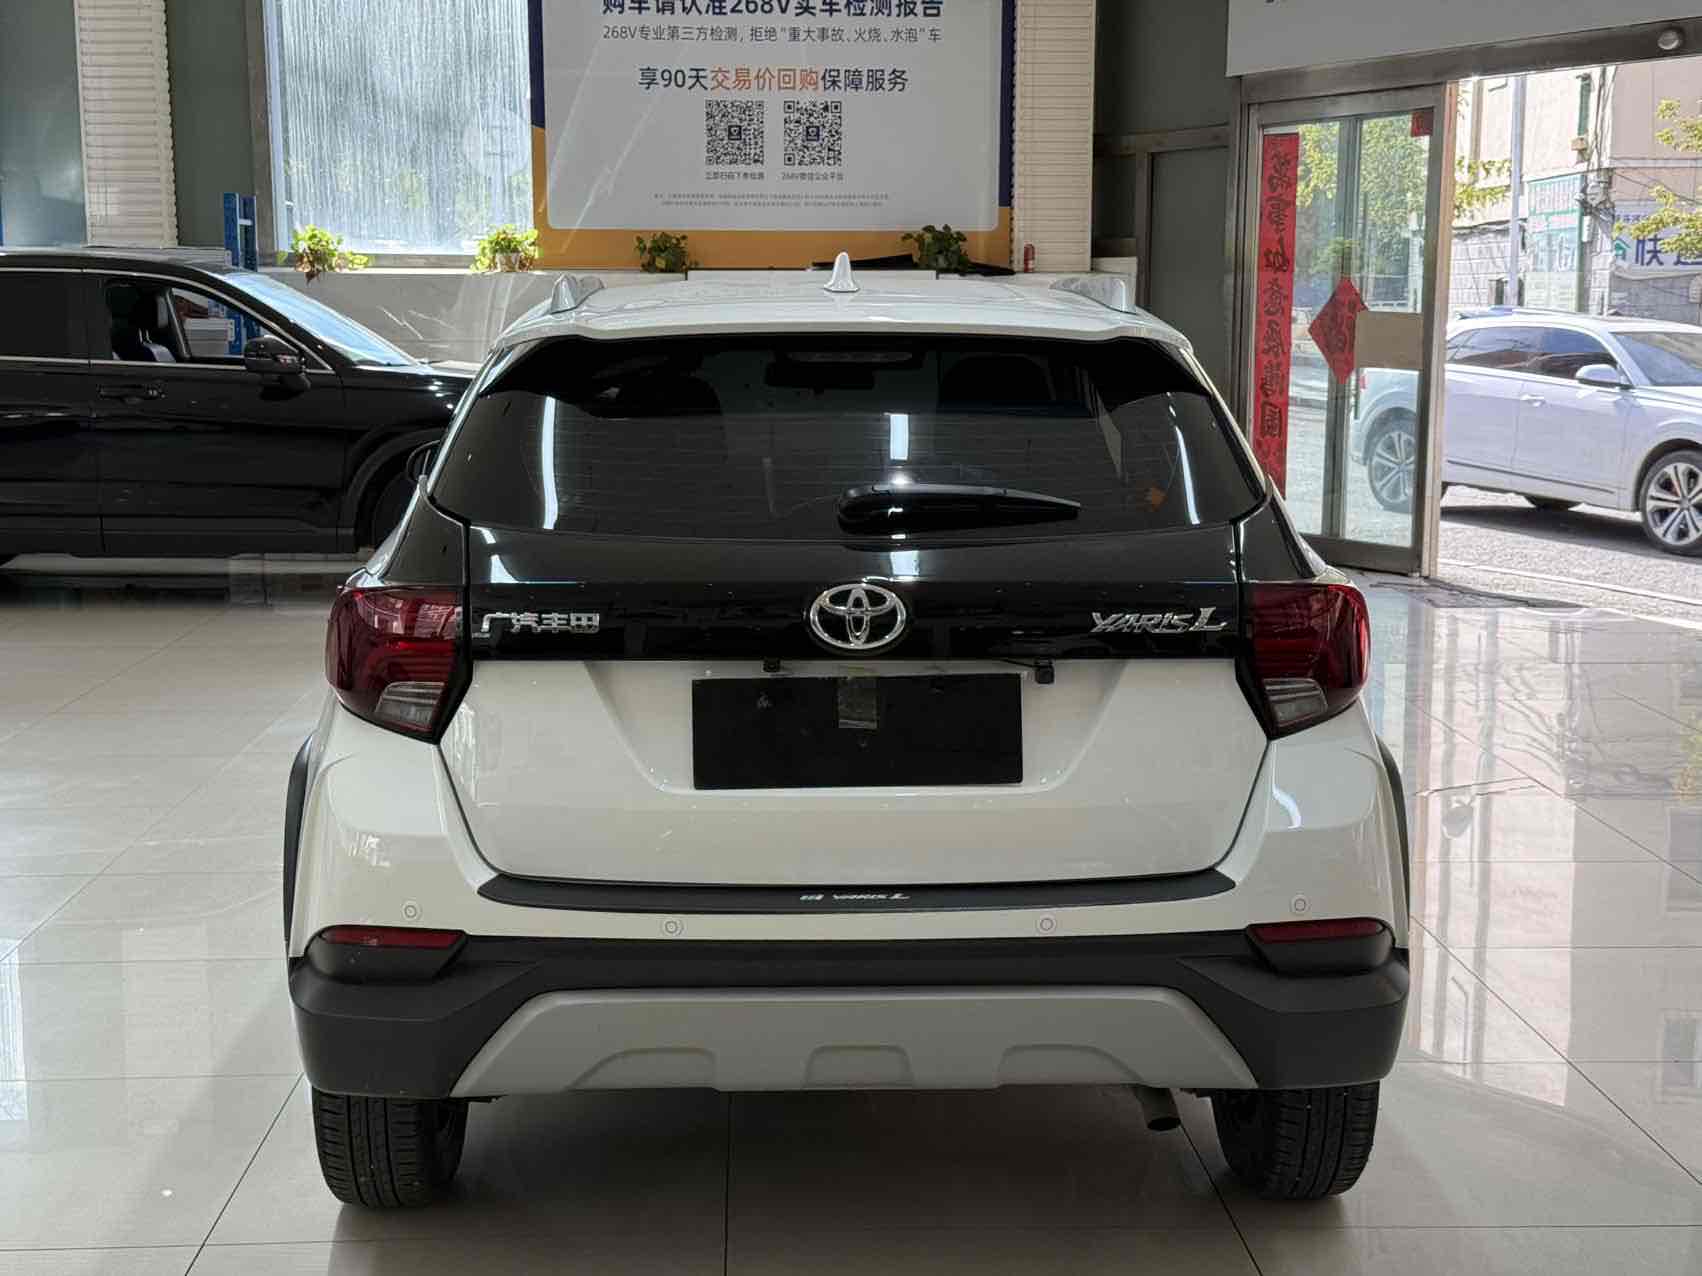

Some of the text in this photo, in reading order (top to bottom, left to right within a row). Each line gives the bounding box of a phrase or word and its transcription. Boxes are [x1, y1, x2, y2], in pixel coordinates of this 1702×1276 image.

[638, 66, 909, 92] 享90天交易价回购保障服务
[472, 612, 599, 638] 广汽丰田
